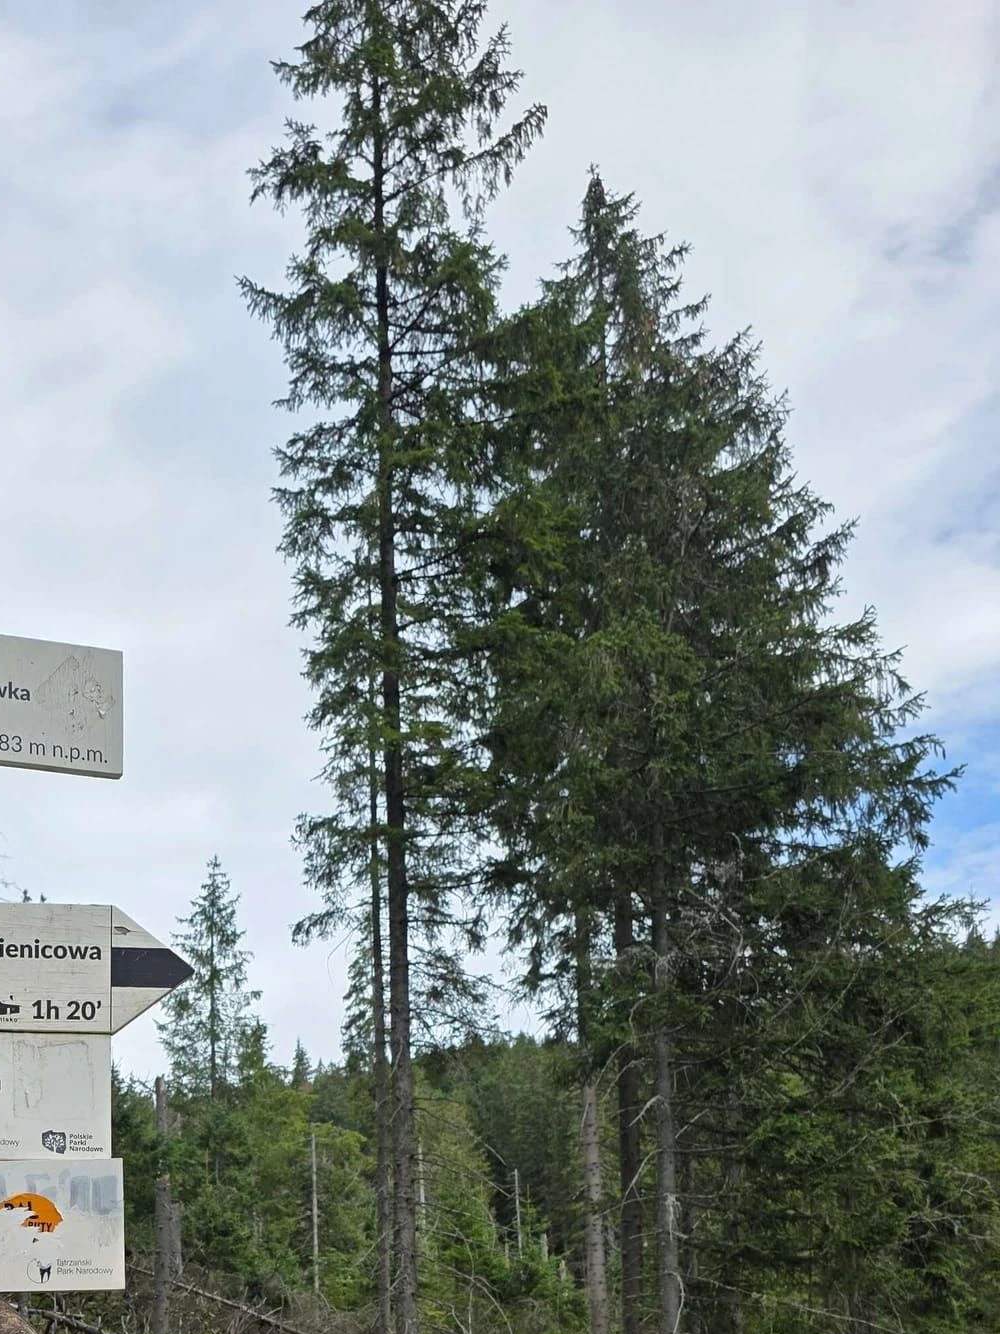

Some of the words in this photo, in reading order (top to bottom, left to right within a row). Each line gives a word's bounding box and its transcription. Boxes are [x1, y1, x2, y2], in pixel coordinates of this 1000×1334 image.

[29, 741, 46, 756] m
[53, 744, 108, 763] n.p.m.
[32, 1000, 60, 1020] 1h
[56, 1267, 74, 1275] Park
[75, 1267, 114, 1276] Narodowy
